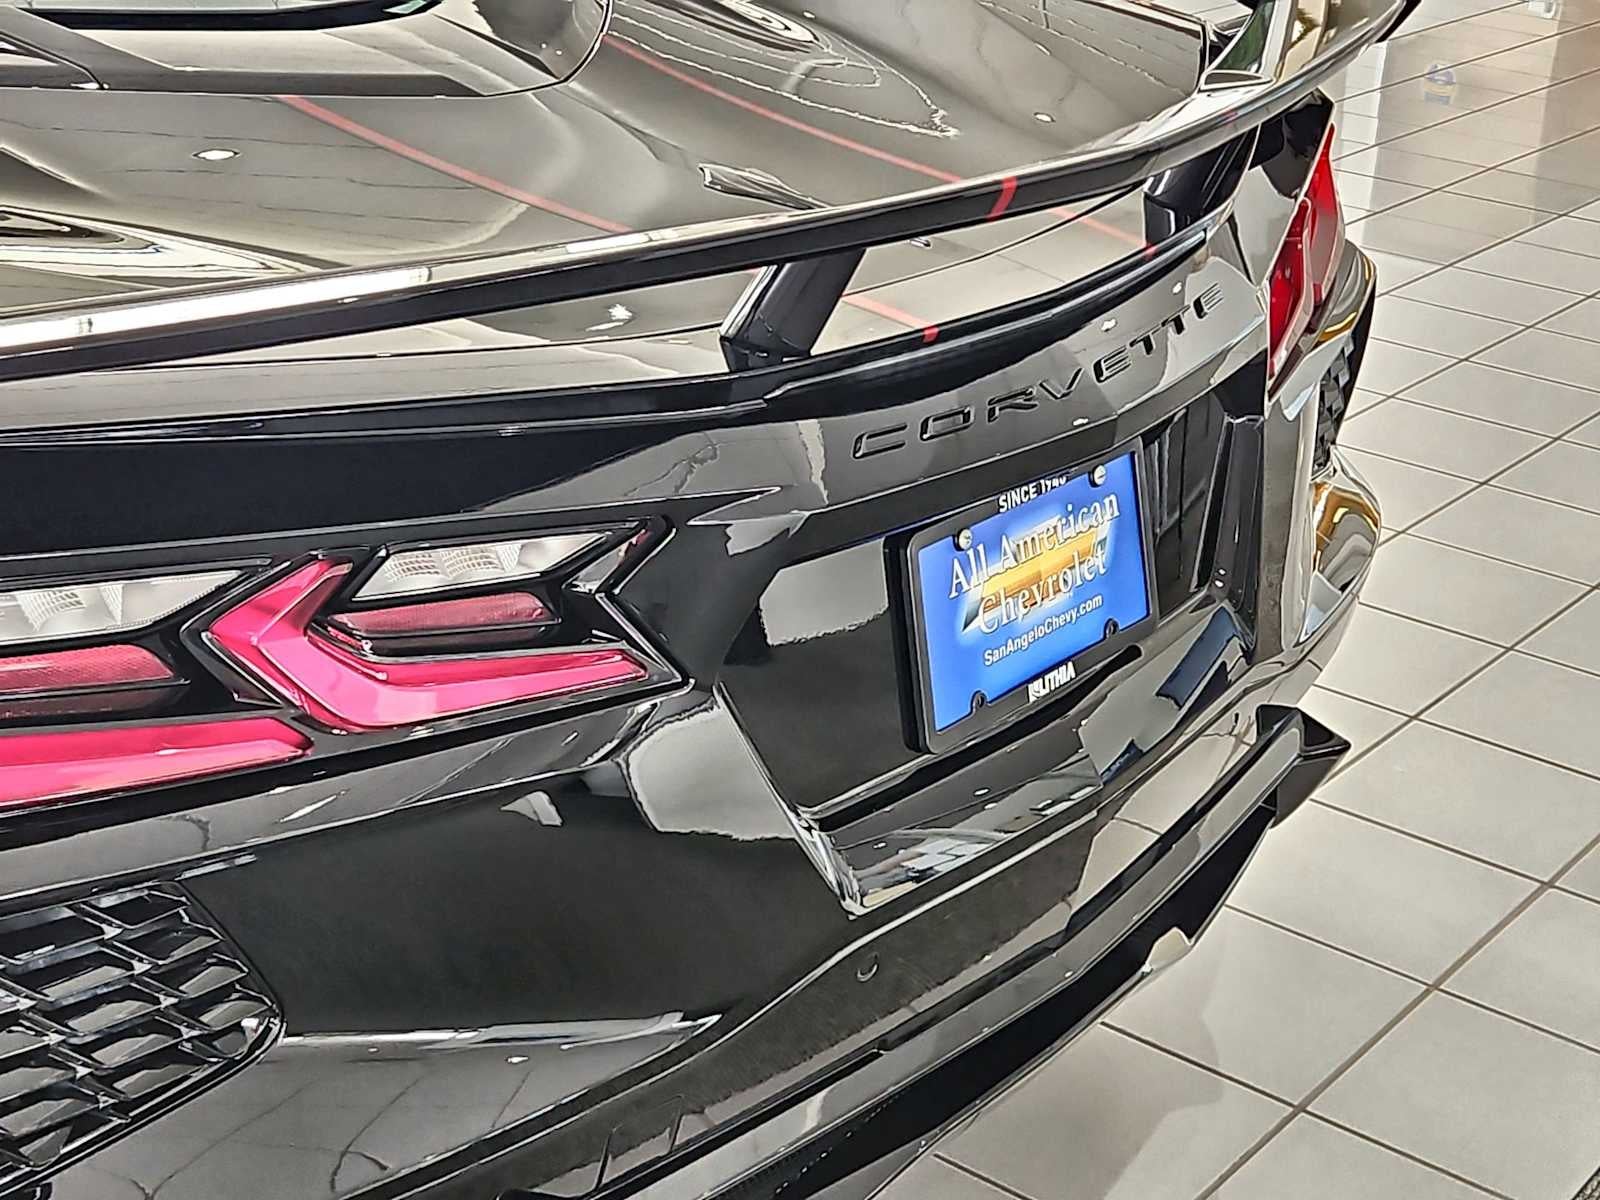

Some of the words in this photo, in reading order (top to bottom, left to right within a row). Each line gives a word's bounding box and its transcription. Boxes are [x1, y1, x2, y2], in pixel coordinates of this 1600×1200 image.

[852, 282, 1225, 459] CORVETTE
[998, 482, 1038, 513] SINCE
[949, 544, 991, 599] All
[1000, 493, 1121, 575] American
[977, 544, 1108, 634] Chevrolet
[983, 593, 1103, 666] SanAngeloChevy.com
[1038, 661, 1077, 696] LITHIA
